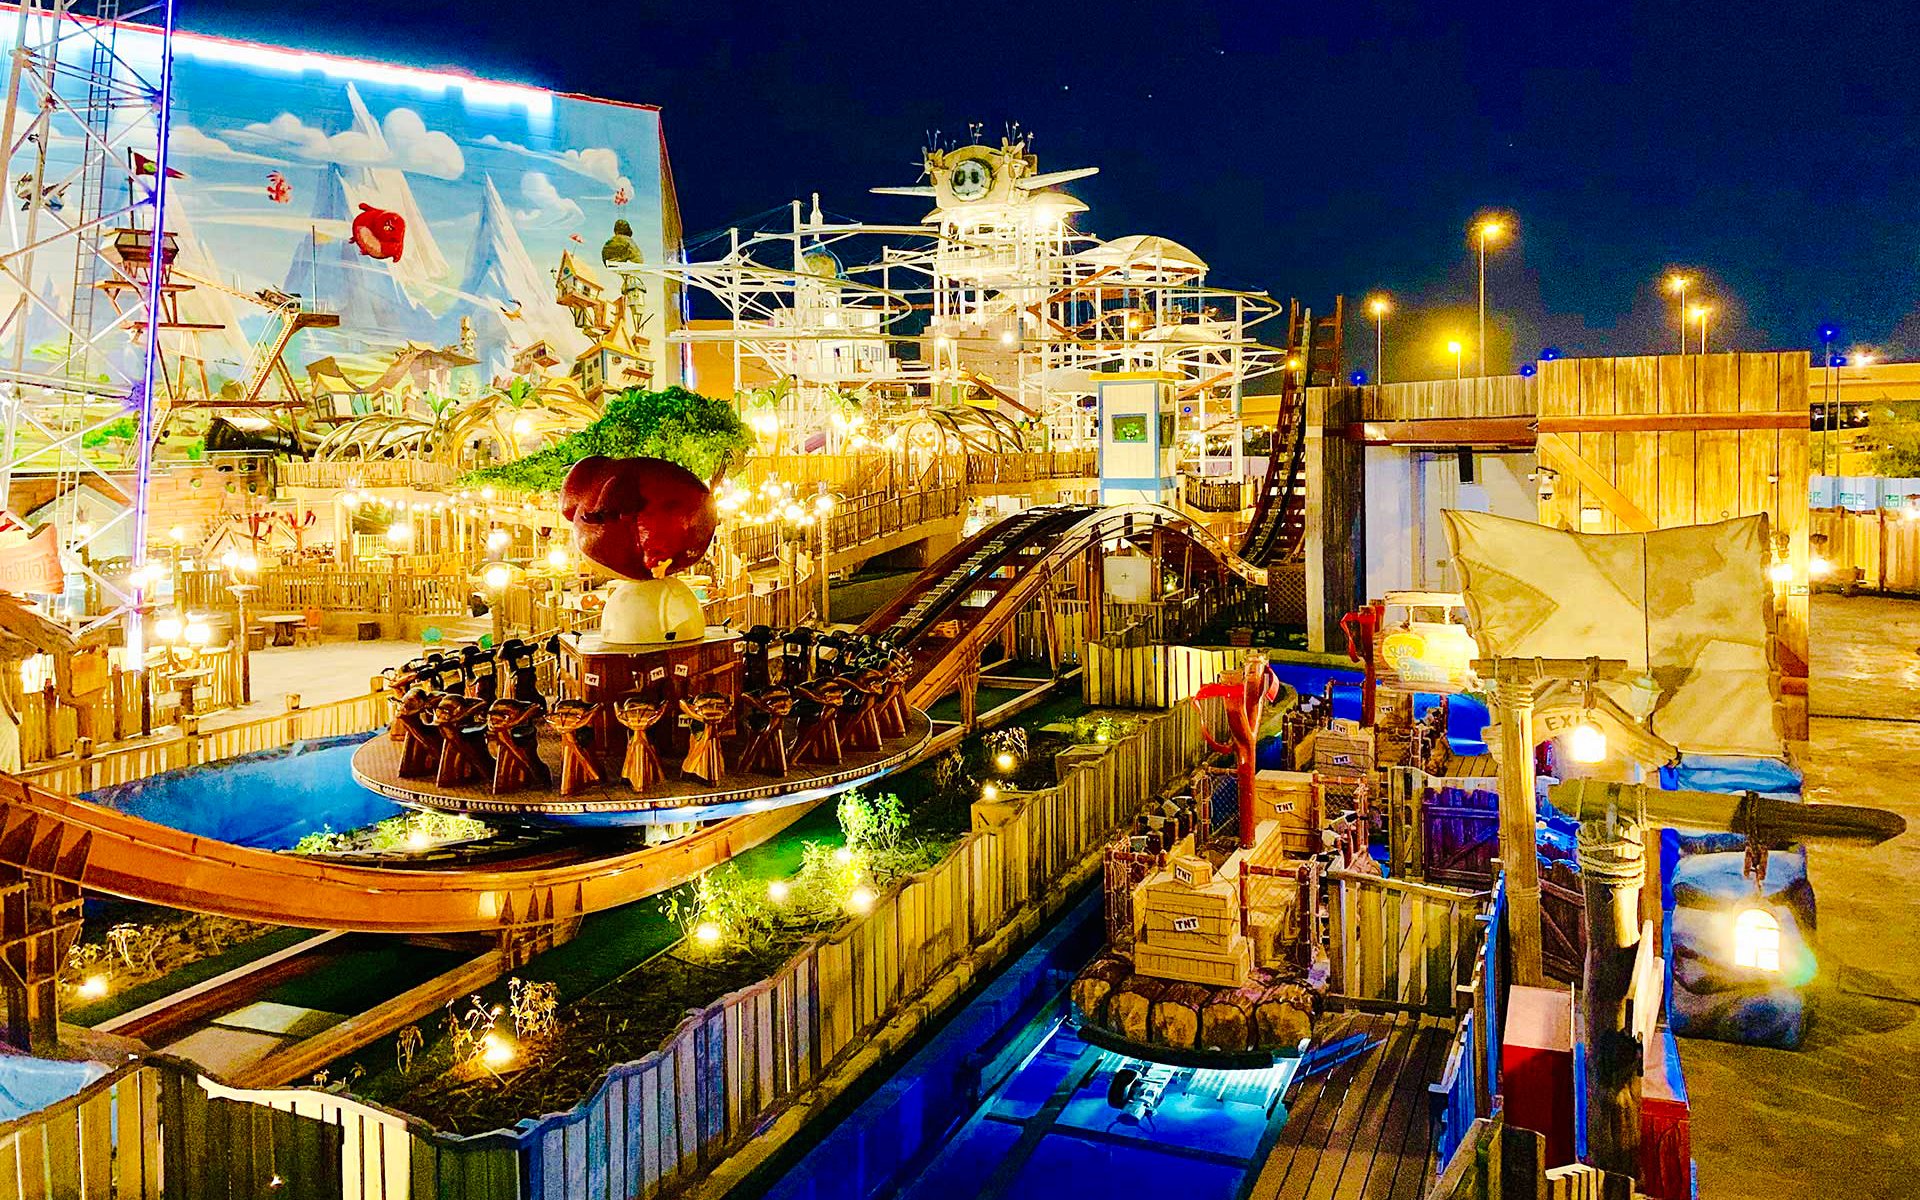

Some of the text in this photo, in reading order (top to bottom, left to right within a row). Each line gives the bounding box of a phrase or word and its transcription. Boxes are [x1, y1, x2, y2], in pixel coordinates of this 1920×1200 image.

[1545, 714, 1581, 732] EXI
[1334, 755, 1349, 763] TNT
[1276, 802, 1293, 812] TNT
[1176, 867, 1192, 882] TNT
[1175, 918, 1197, 930] TNT
